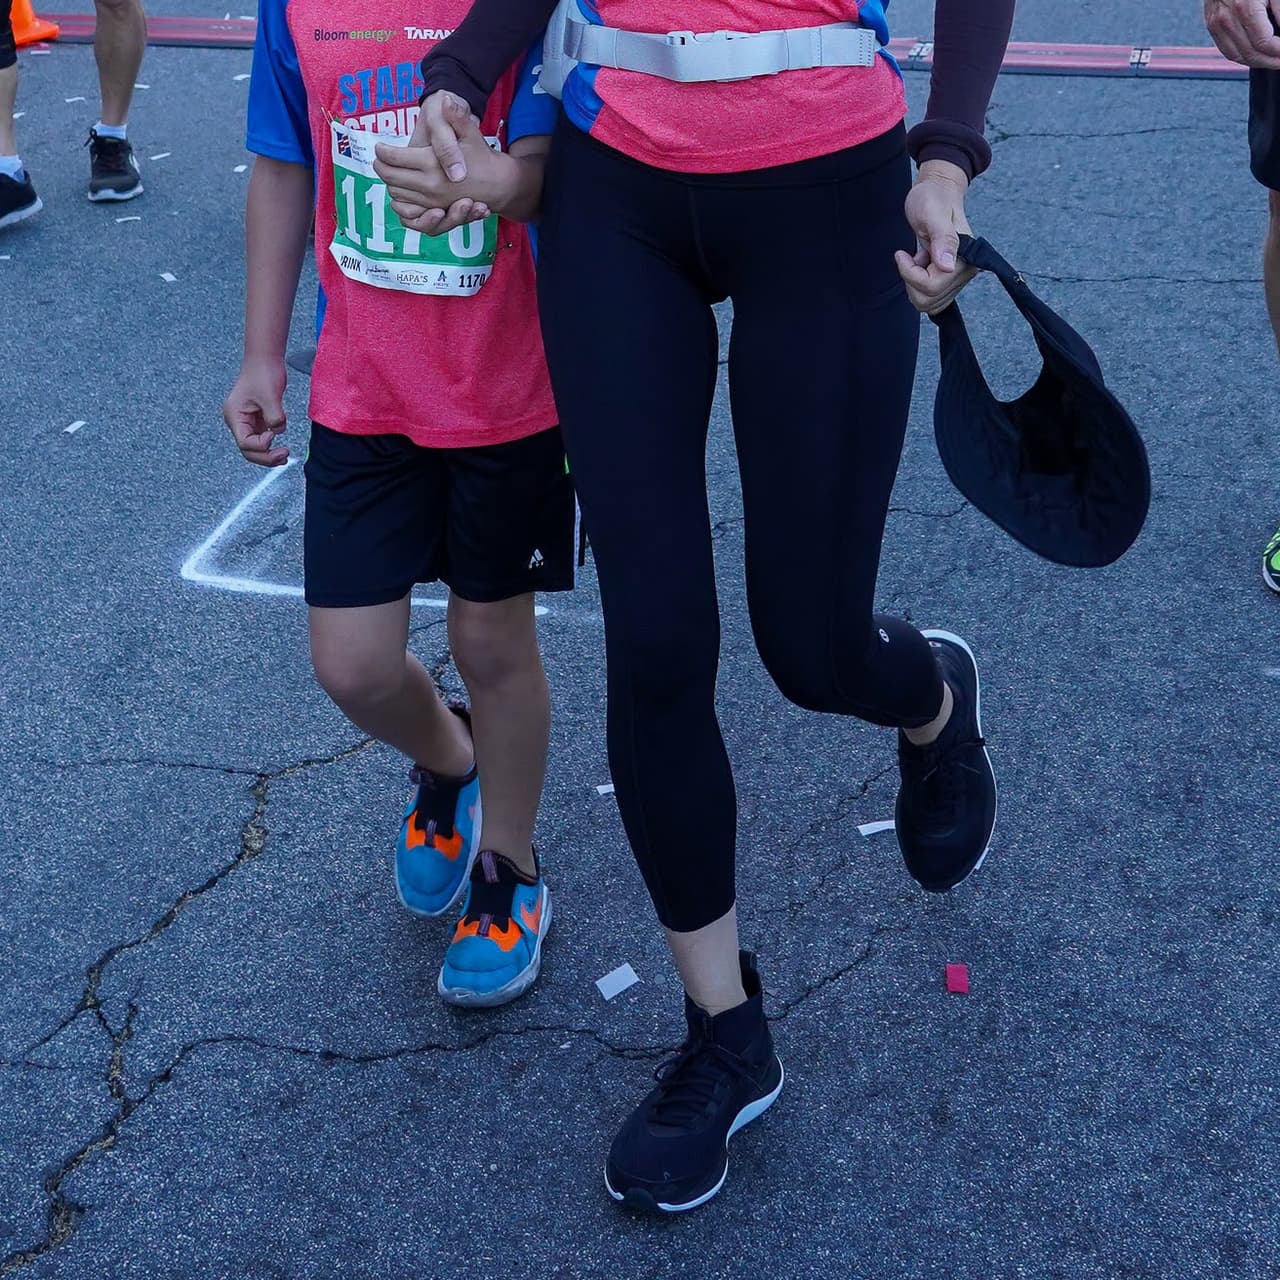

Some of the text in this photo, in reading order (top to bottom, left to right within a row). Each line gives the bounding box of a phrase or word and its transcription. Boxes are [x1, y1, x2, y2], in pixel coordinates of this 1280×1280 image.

[404, 26, 456, 40] TARAN
[340, 255, 361, 272] RINK
[458, 273, 486, 288] 1170
